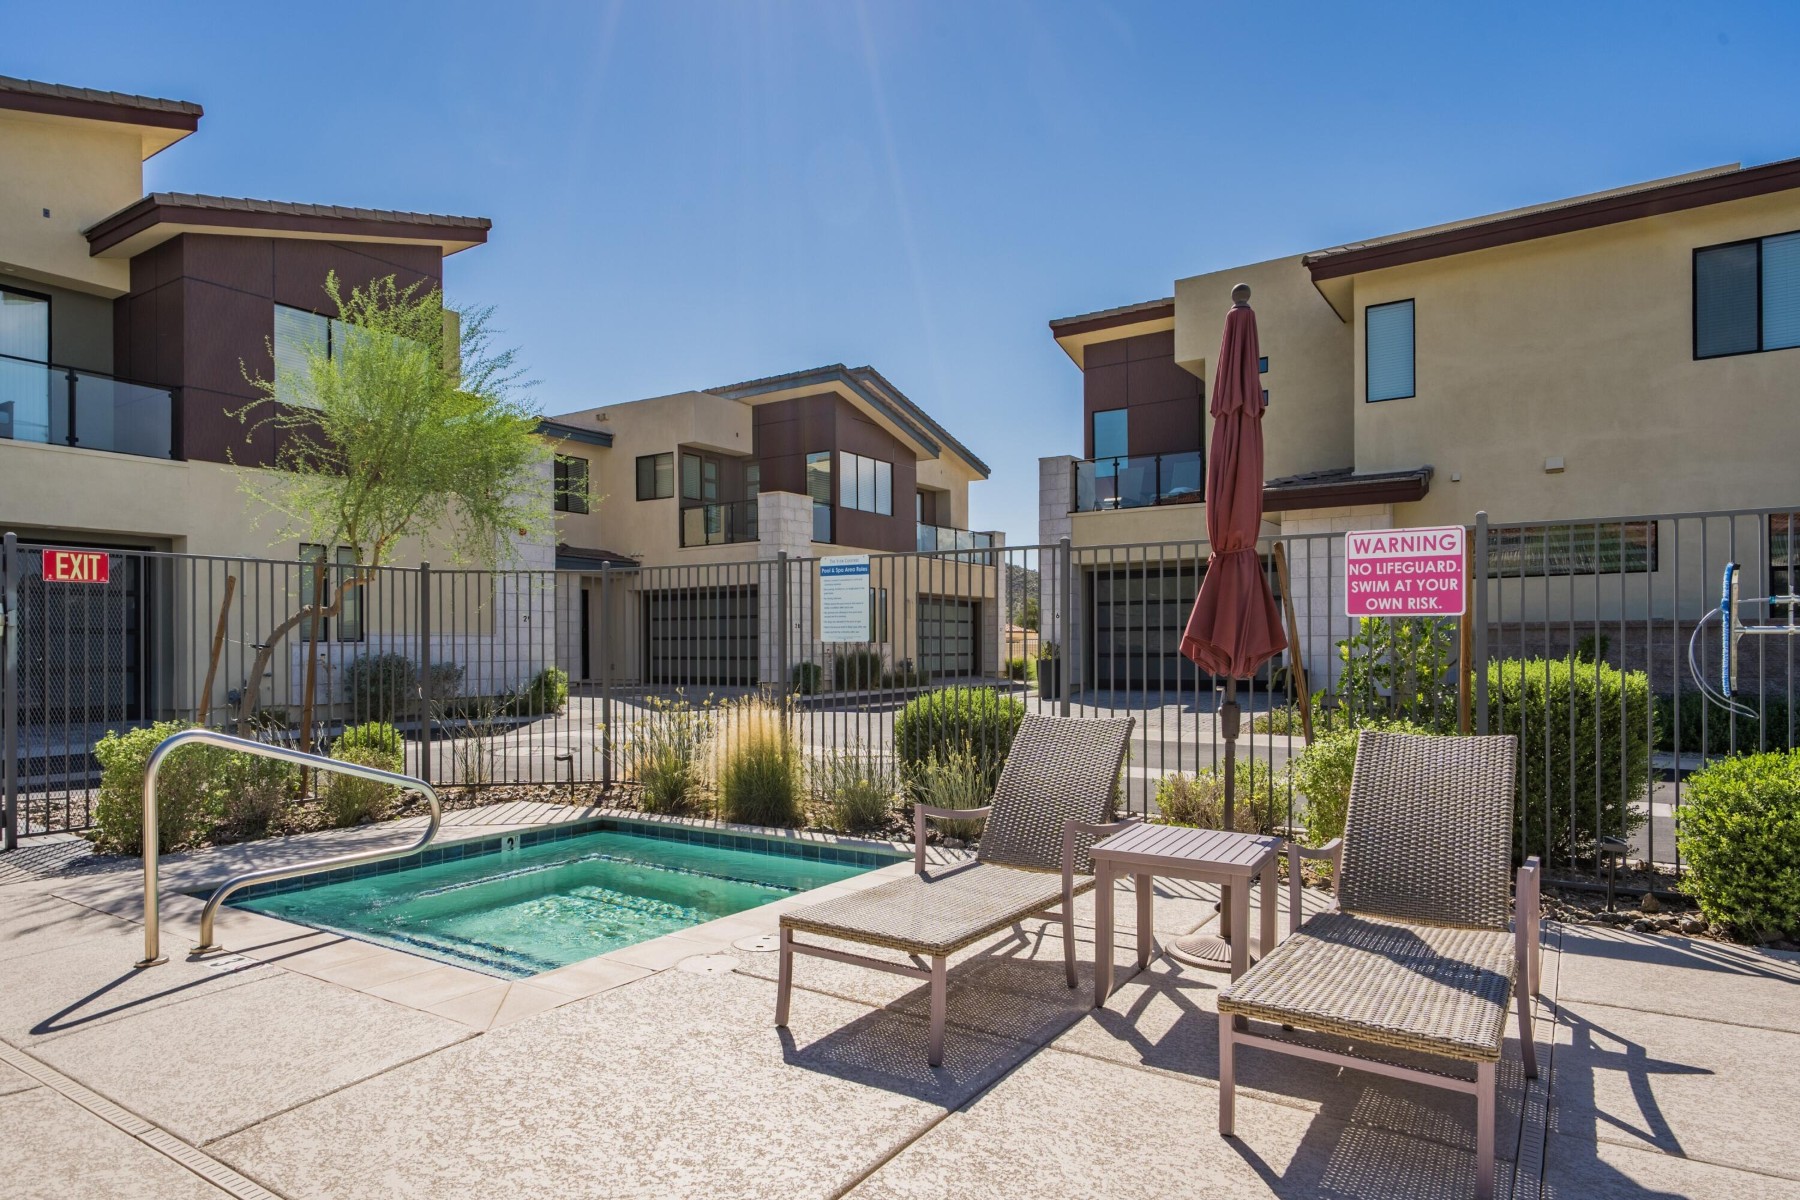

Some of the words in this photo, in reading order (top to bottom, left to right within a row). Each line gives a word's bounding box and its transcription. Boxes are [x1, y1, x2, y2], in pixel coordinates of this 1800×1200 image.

[1353, 534, 1457, 554] WARNING
[55, 552, 101, 581] EXIT
[1349, 563, 1372, 576] NO
[1376, 560, 1461, 575] LIFEGUARD.
[1351, 580, 1390, 593] SWIM
[1394, 579, 1412, 592] AT
[1416, 578, 1458, 591] YOUR
[1366, 597, 1402, 610] OWN
[1408, 596, 1443, 610] RISK.
